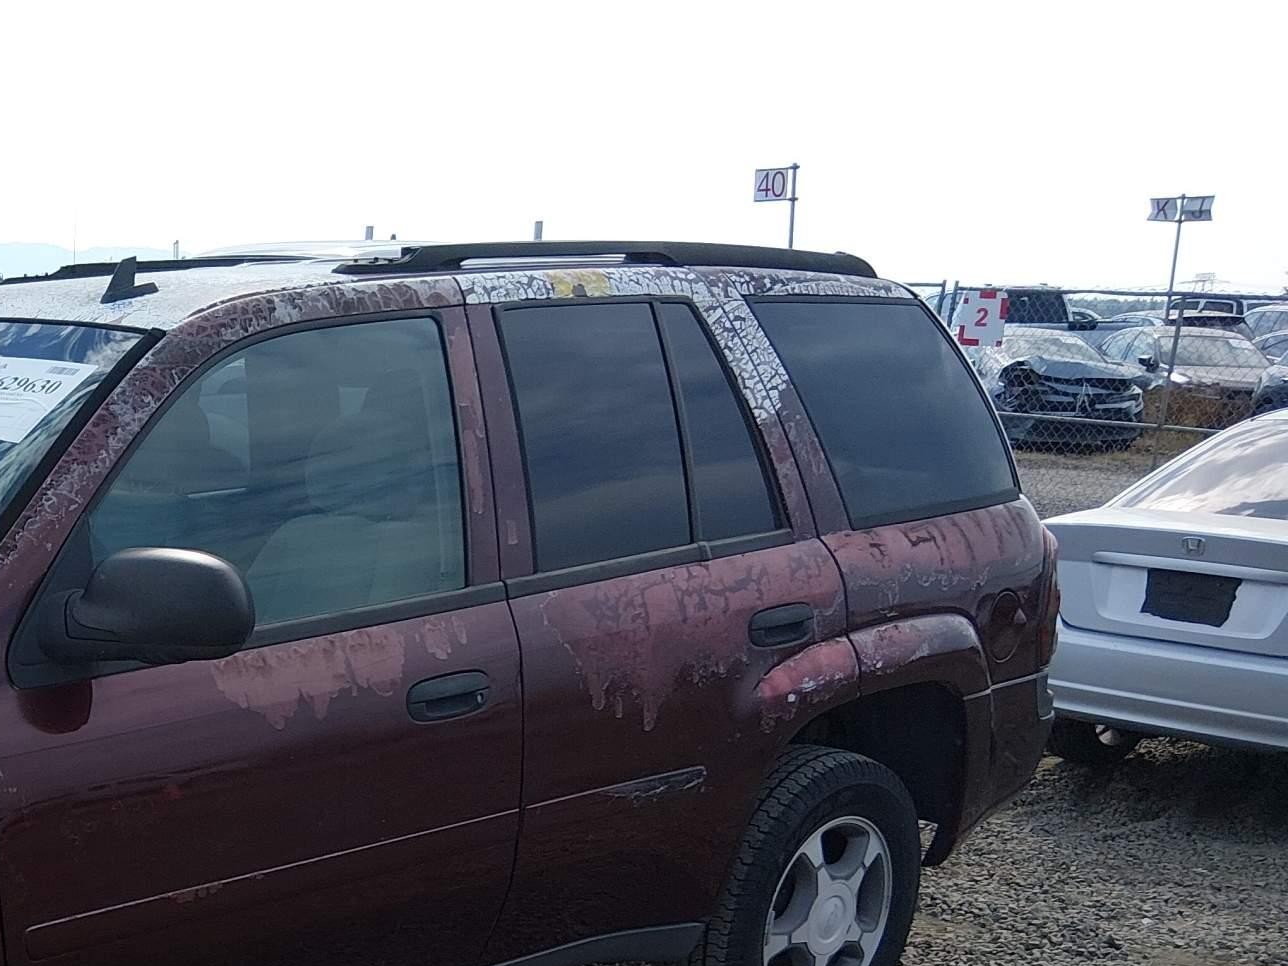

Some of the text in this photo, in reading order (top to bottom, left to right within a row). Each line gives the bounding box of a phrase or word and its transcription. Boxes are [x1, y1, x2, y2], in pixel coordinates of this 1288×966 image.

[756, 170, 786, 198] 40
[1154, 199, 1170, 219] K
[1192, 198, 1206, 219] J
[974, 307, 989, 327] 2
